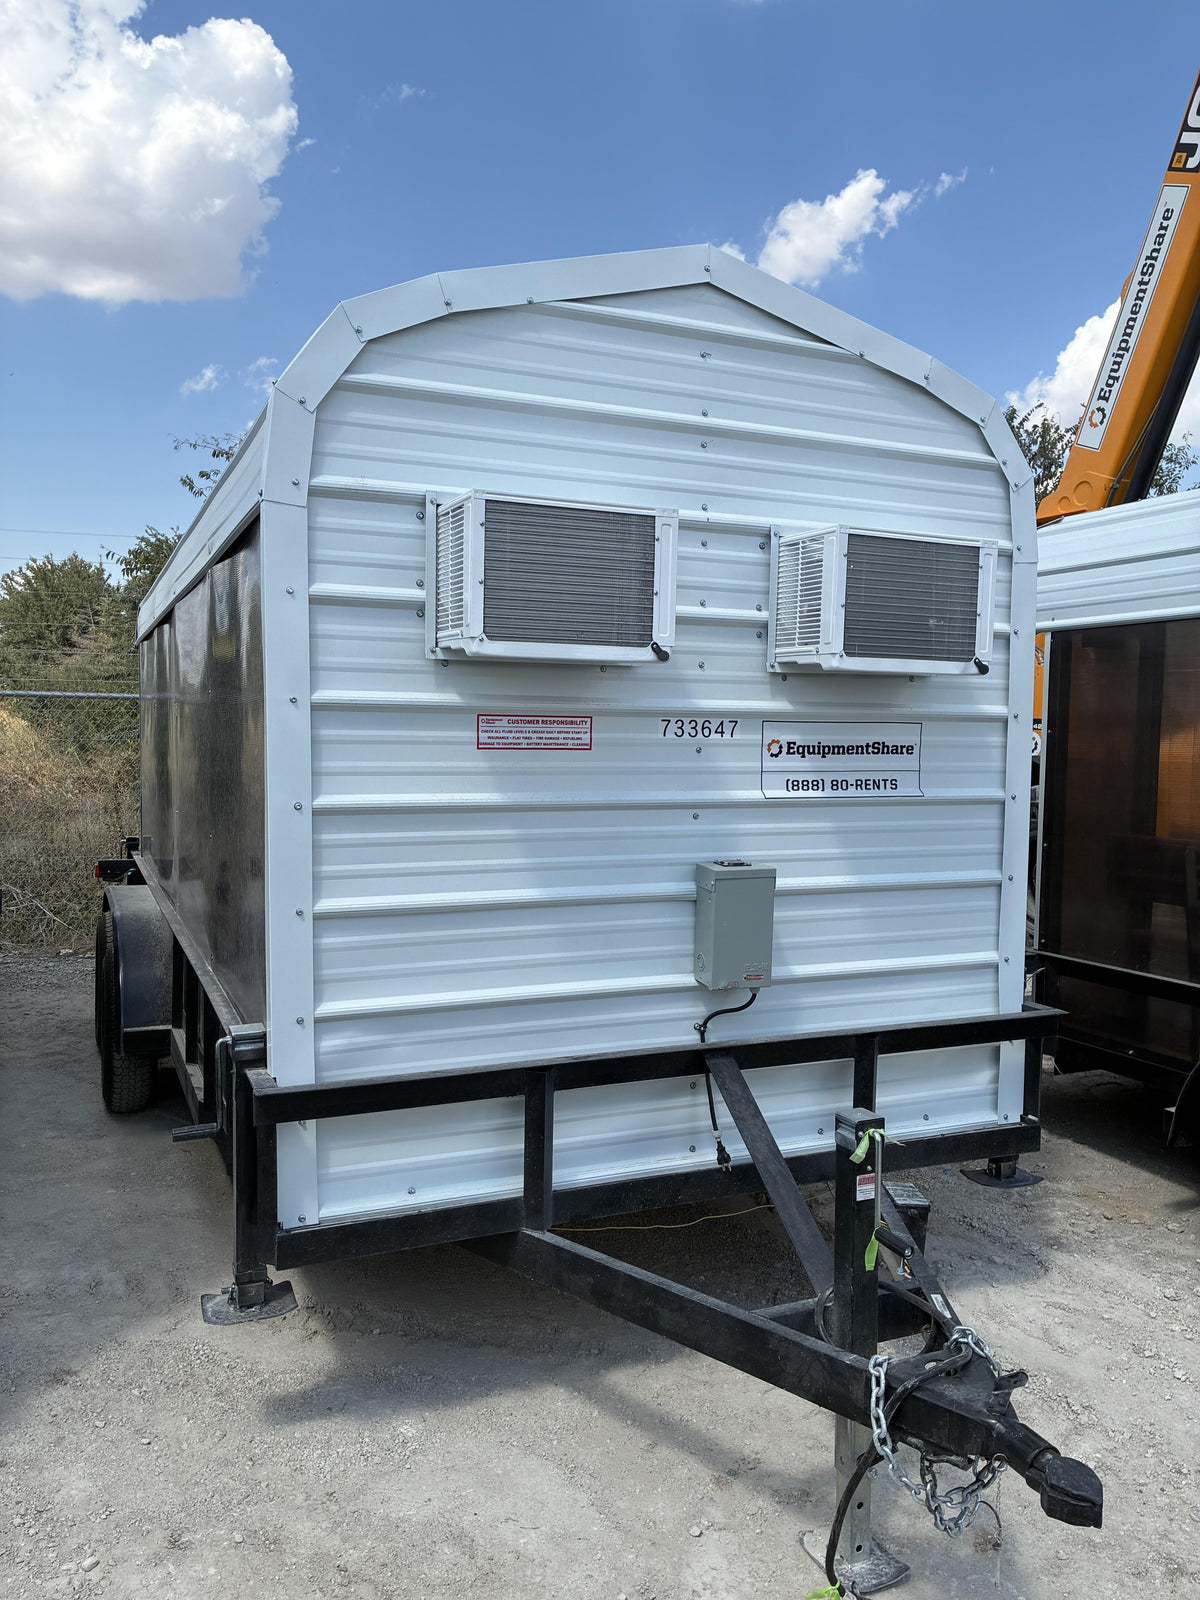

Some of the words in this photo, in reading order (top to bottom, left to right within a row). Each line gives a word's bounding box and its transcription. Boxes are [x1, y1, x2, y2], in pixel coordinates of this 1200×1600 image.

[1097, 207, 1174, 403] EquipmentShare
[660, 719, 738, 738] 733647
[786, 741, 914, 758] EquipmentShare
[785, 780, 825, 792] (888)
[830, 779, 898, 792] 80-RENTS
